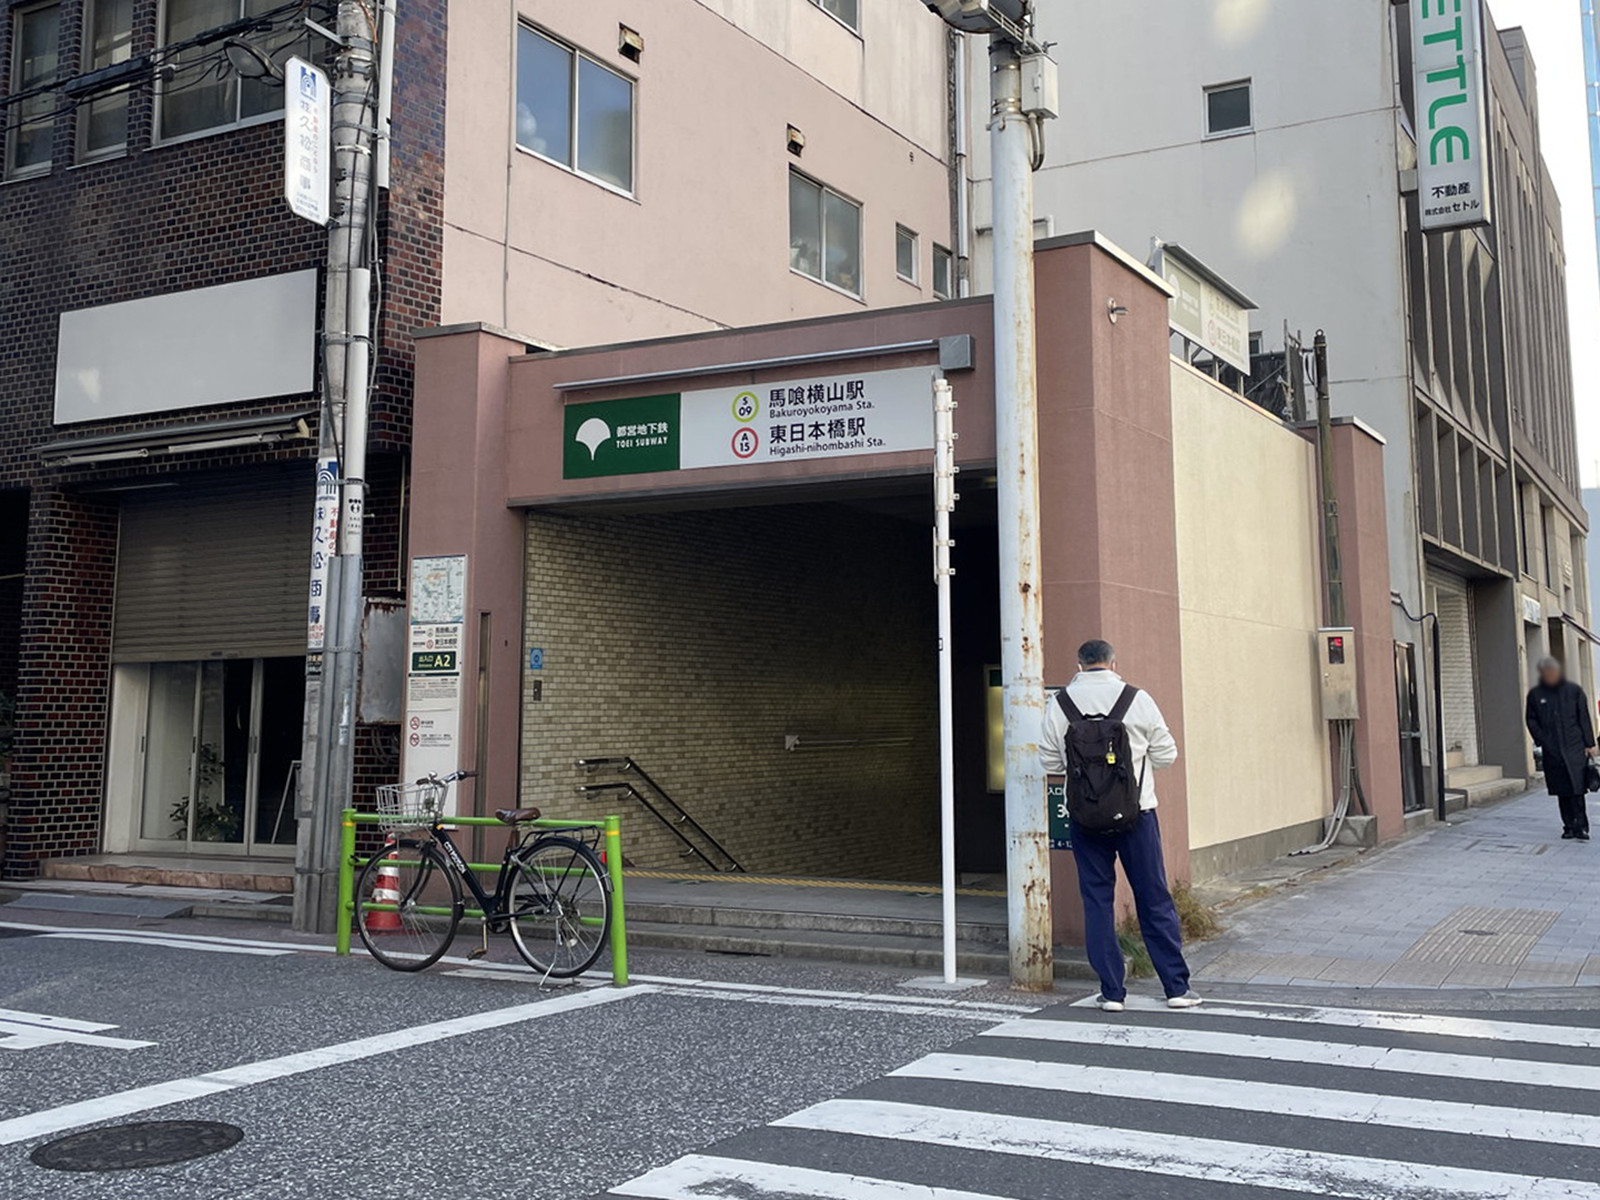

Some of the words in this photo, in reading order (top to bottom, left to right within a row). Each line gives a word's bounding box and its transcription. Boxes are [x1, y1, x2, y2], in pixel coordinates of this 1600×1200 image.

[1431, 181, 1471, 199] 不動産
[1425, 199, 1480, 216] 株式会社セトル
[742, 396, 748, 406] S
[768, 379, 865, 408] 馬喰横山駅
[738, 405, 753, 417] 09
[769, 403, 854, 419] Bakuroyokoyama
[856, 400, 875, 410] Sta.
[616, 421, 669, 437] 都営地下鉄
[741, 432, 749, 441] A
[769, 416, 866, 444] 東日本橋駅
[616, 439, 633, 448] TOEI
[635, 436, 668, 447] SUBWAY
[739, 442, 750, 452] 15
[769, 437, 865, 457] Higashi-nihombashi
[866, 437, 886, 447] Sta.
[434, 653, 451, 668] A2
